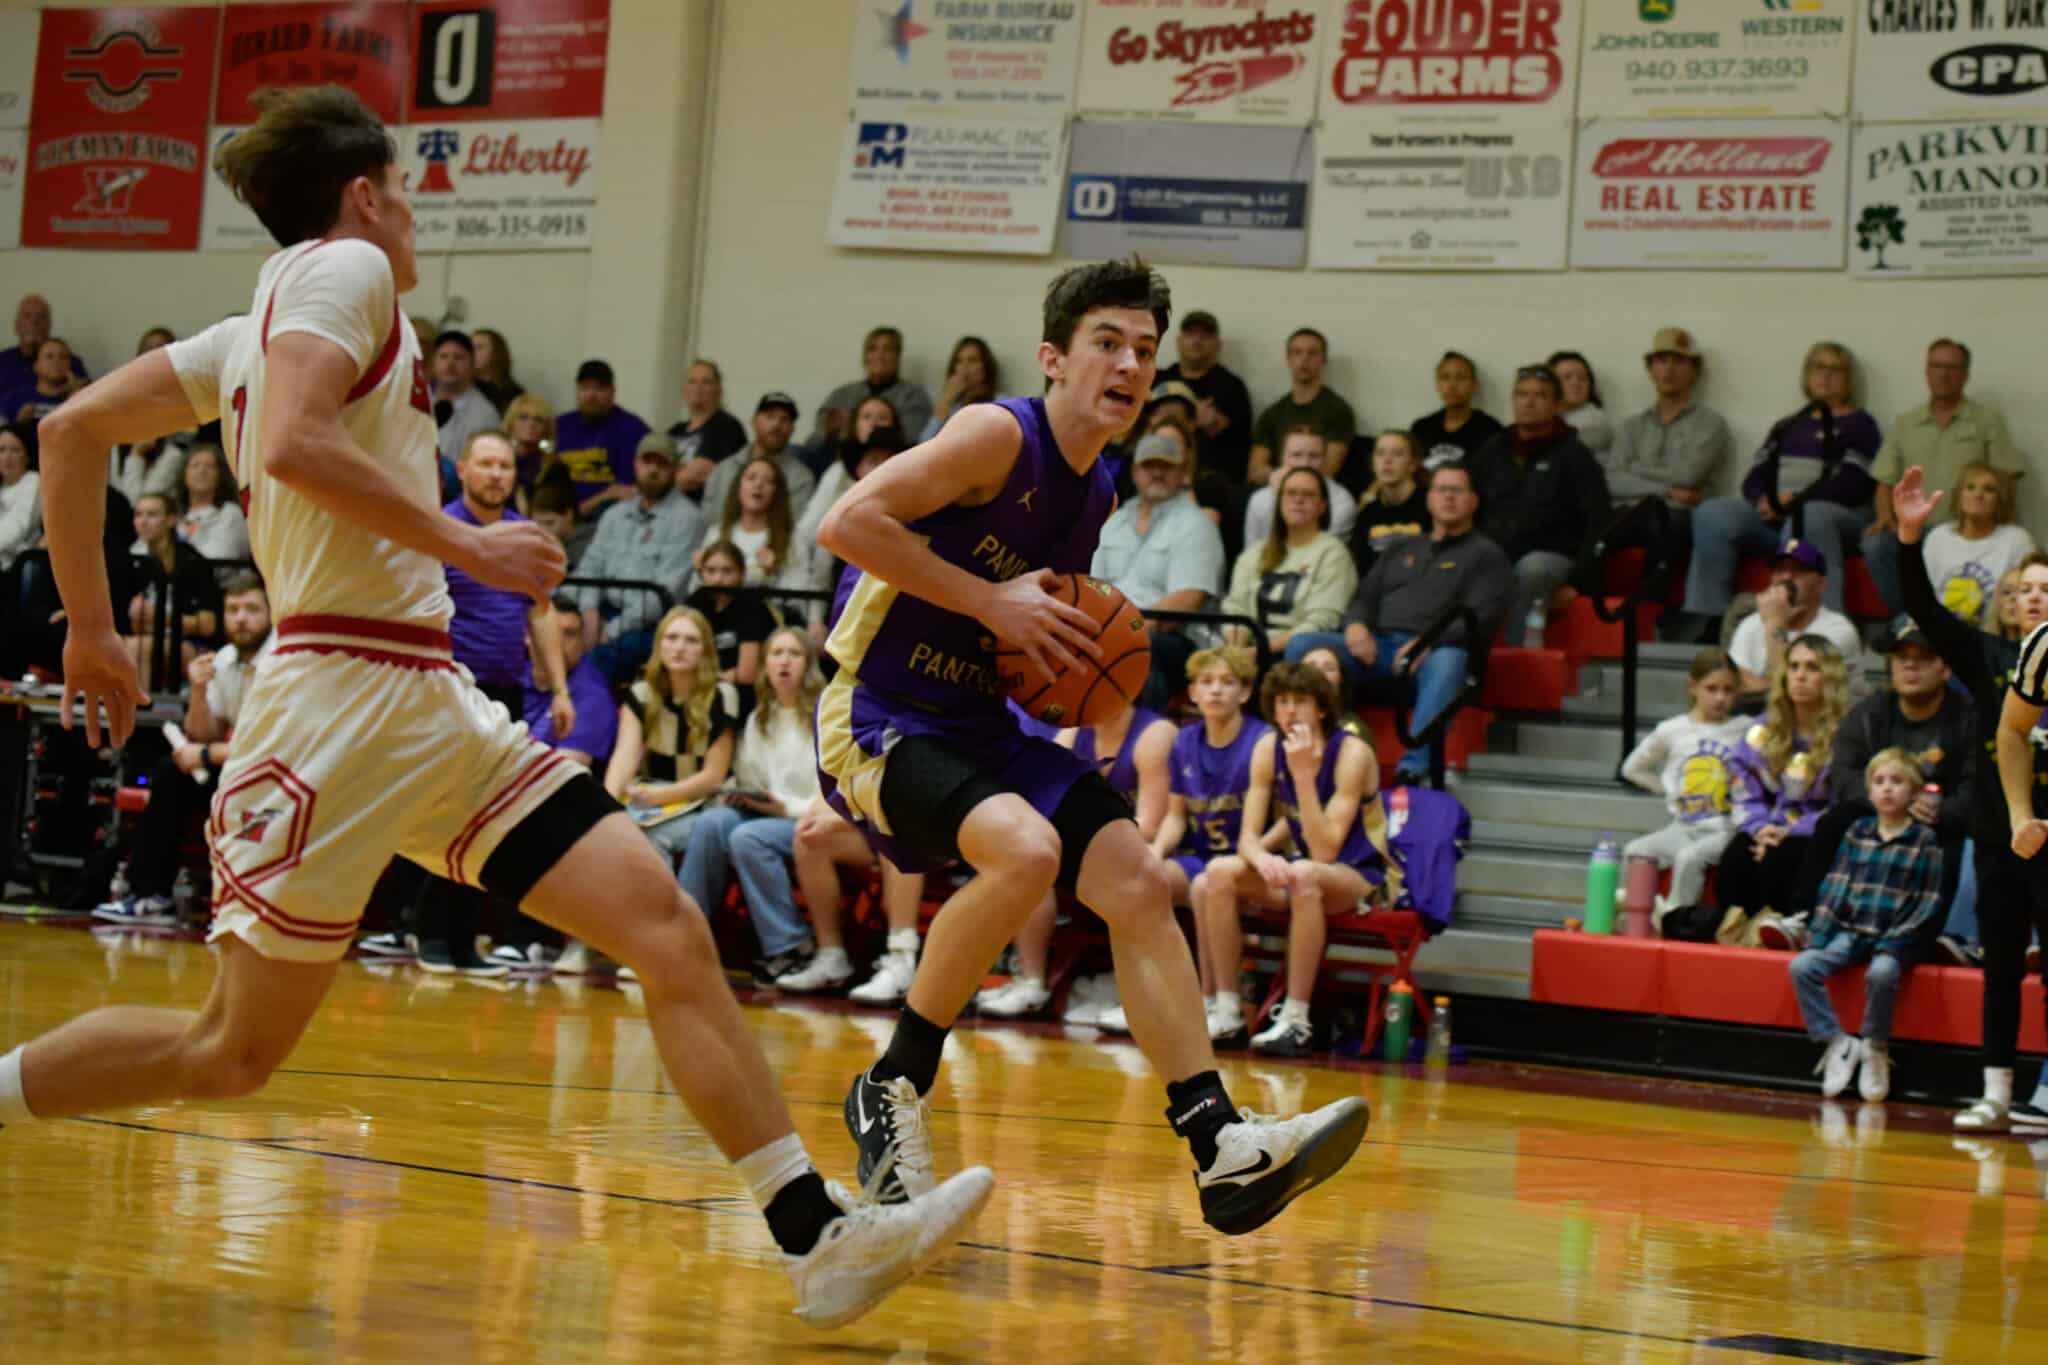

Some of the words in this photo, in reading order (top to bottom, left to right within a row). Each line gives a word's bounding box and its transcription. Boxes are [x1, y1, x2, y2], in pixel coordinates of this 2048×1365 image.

[934, 1, 990, 18] FARM
[996, 1, 1075, 20] BUREAU
[1341, 0, 1560, 50] SOUDER
[1742, 16, 1844, 36] WESTERN
[947, 24, 1055, 43] INSURANCE
[1108, 27, 1148, 65] Go
[1153, 9, 1315, 63] Skyrockets
[1592, 31, 1648, 51] JOHN
[1650, 29, 1720, 49] DEERE
[1343, 55, 1550, 97] FARMS
[1943, 53, 2048, 86] CPA
[461, 133, 591, 188] Liberty
[1649, 140, 1830, 174] Holland
[1867, 125, 2048, 182] PARKVI
[1907, 165, 2048, 195] MANO
[1600, 184, 1681, 211] REAL
[1697, 184, 1817, 211] ESTATE
